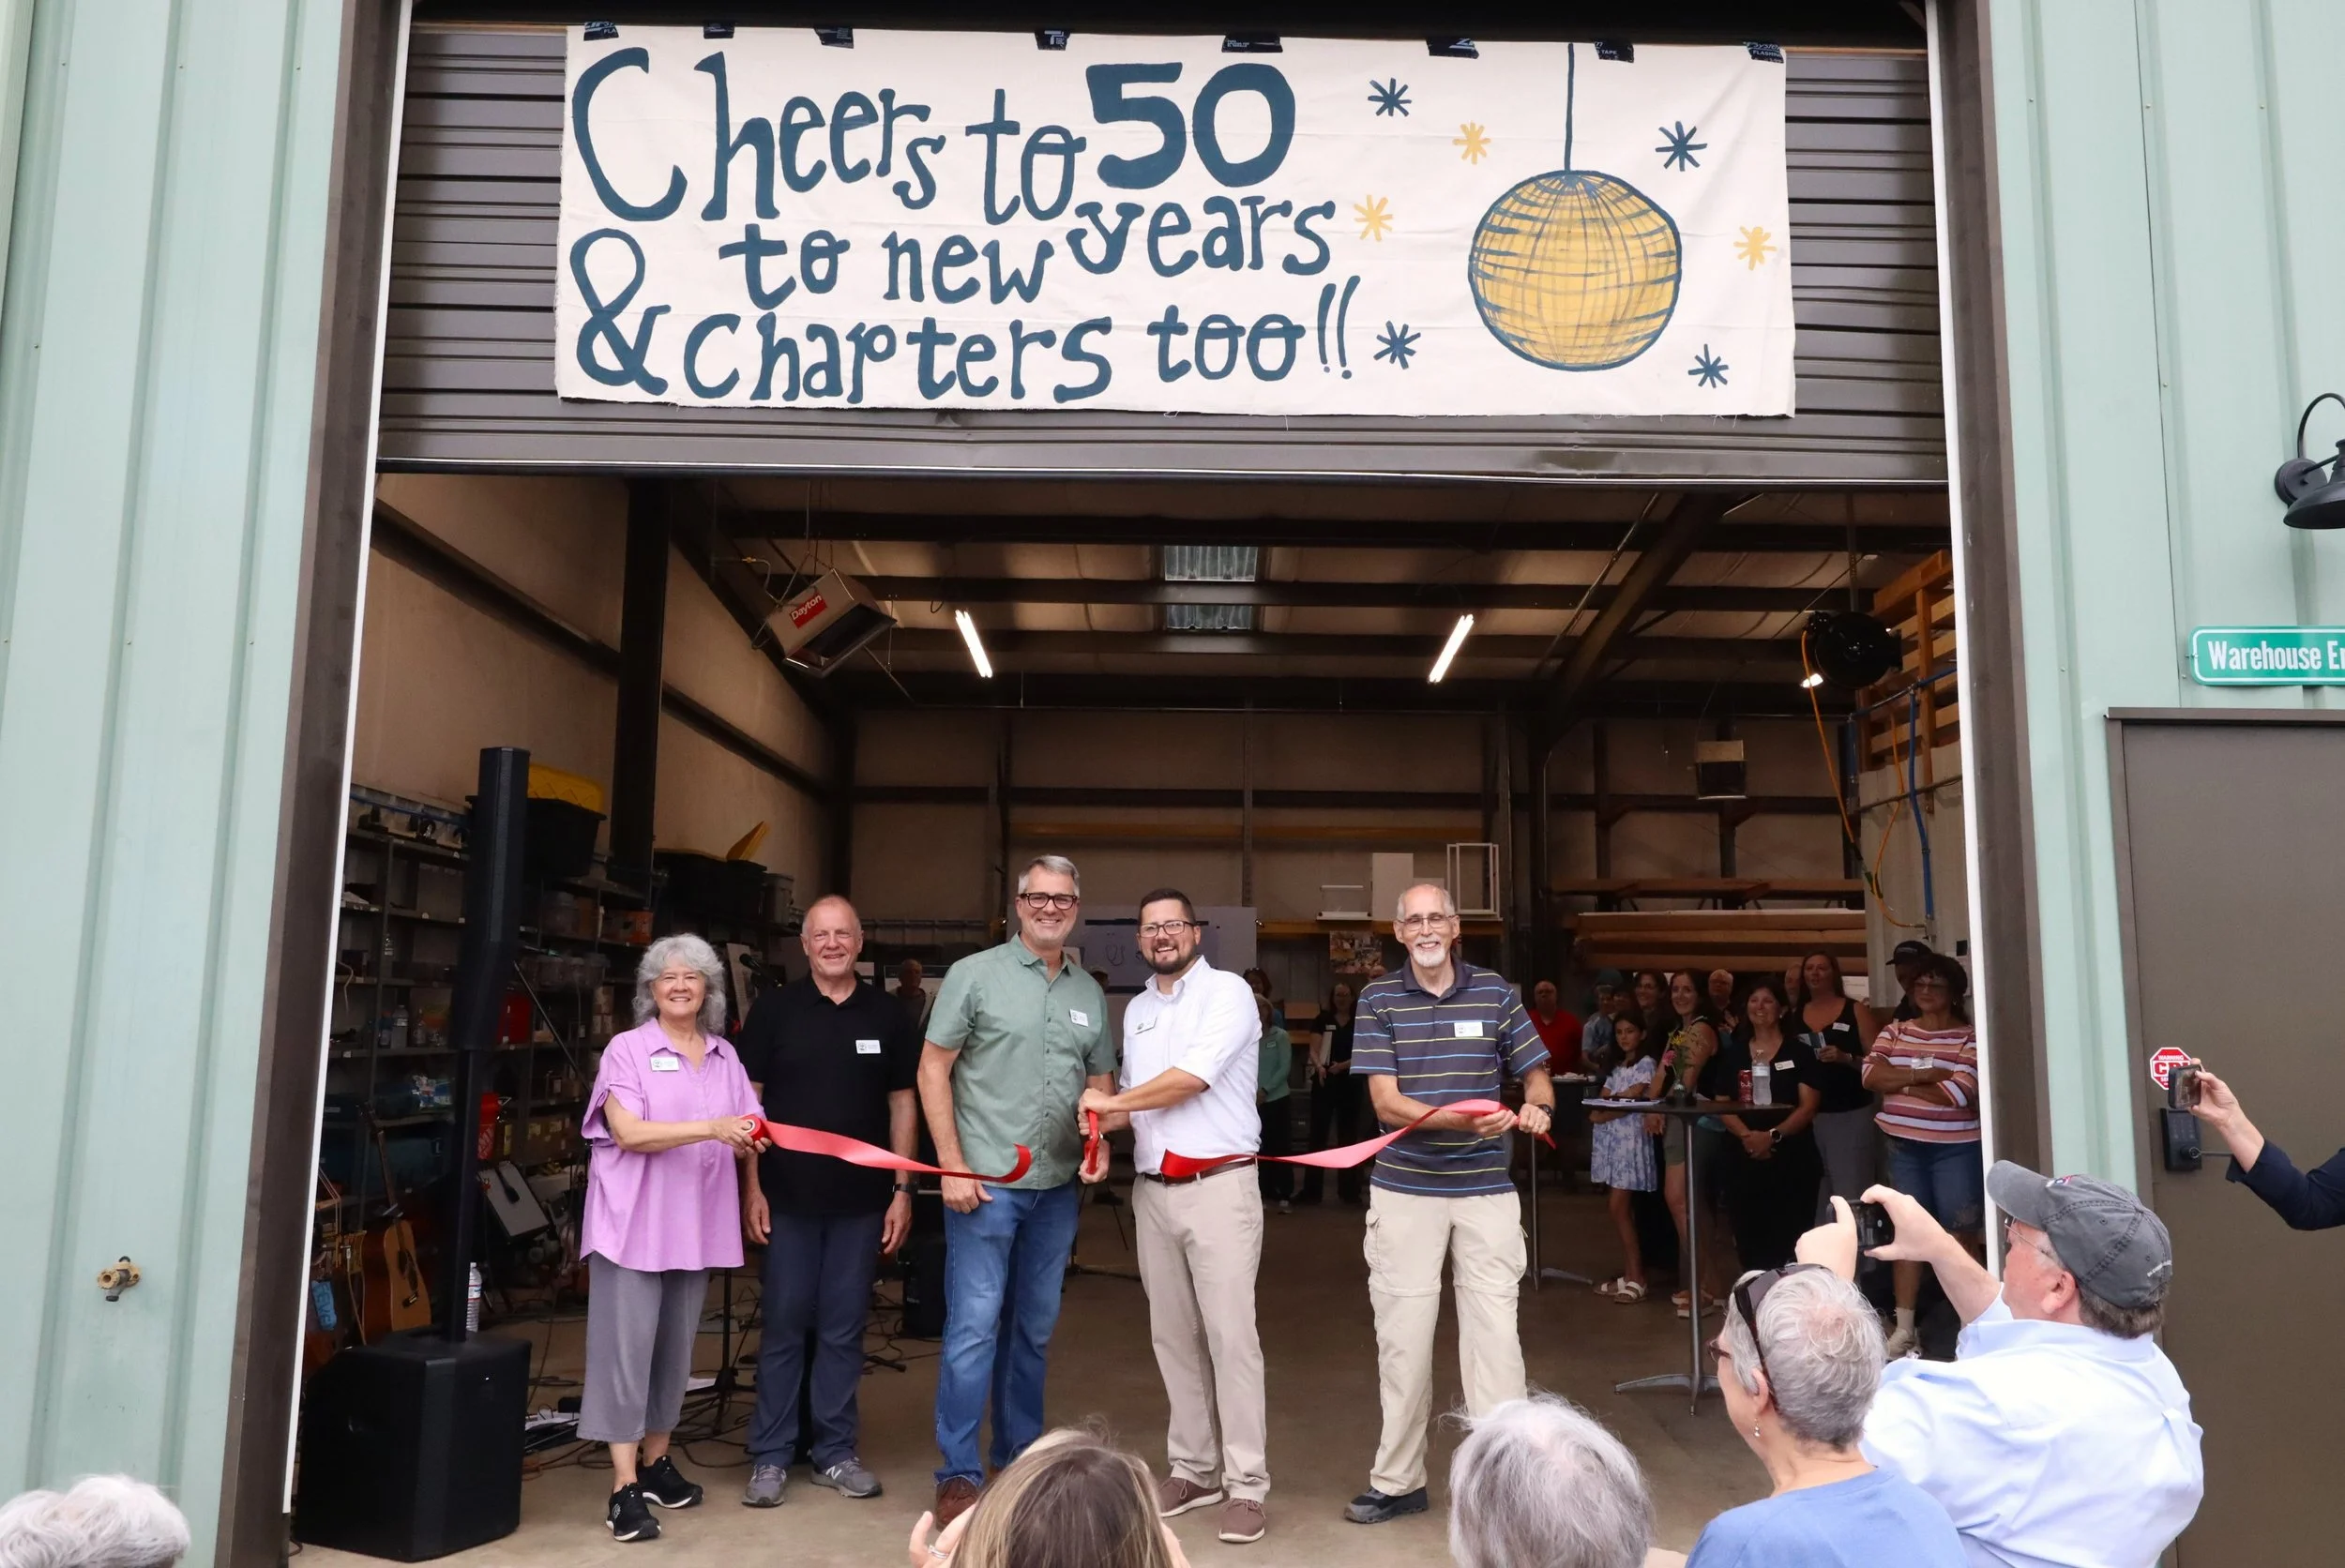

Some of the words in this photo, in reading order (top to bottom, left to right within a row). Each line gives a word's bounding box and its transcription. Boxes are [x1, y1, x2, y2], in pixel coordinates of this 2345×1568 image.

[572, 47, 946, 221] Cheers
[965, 88, 1087, 225] to
[1085, 62, 1295, 189] 50
[1066, 195, 1336, 278] years
[569, 228, 672, 395] &
[719, 223, 851, 309] to
[883, 231, 1054, 305] new
[1147, 276, 1360, 382] too!!
[791, 594, 823, 621] Dayton
[2207, 640, 2322, 671] Warehouse
